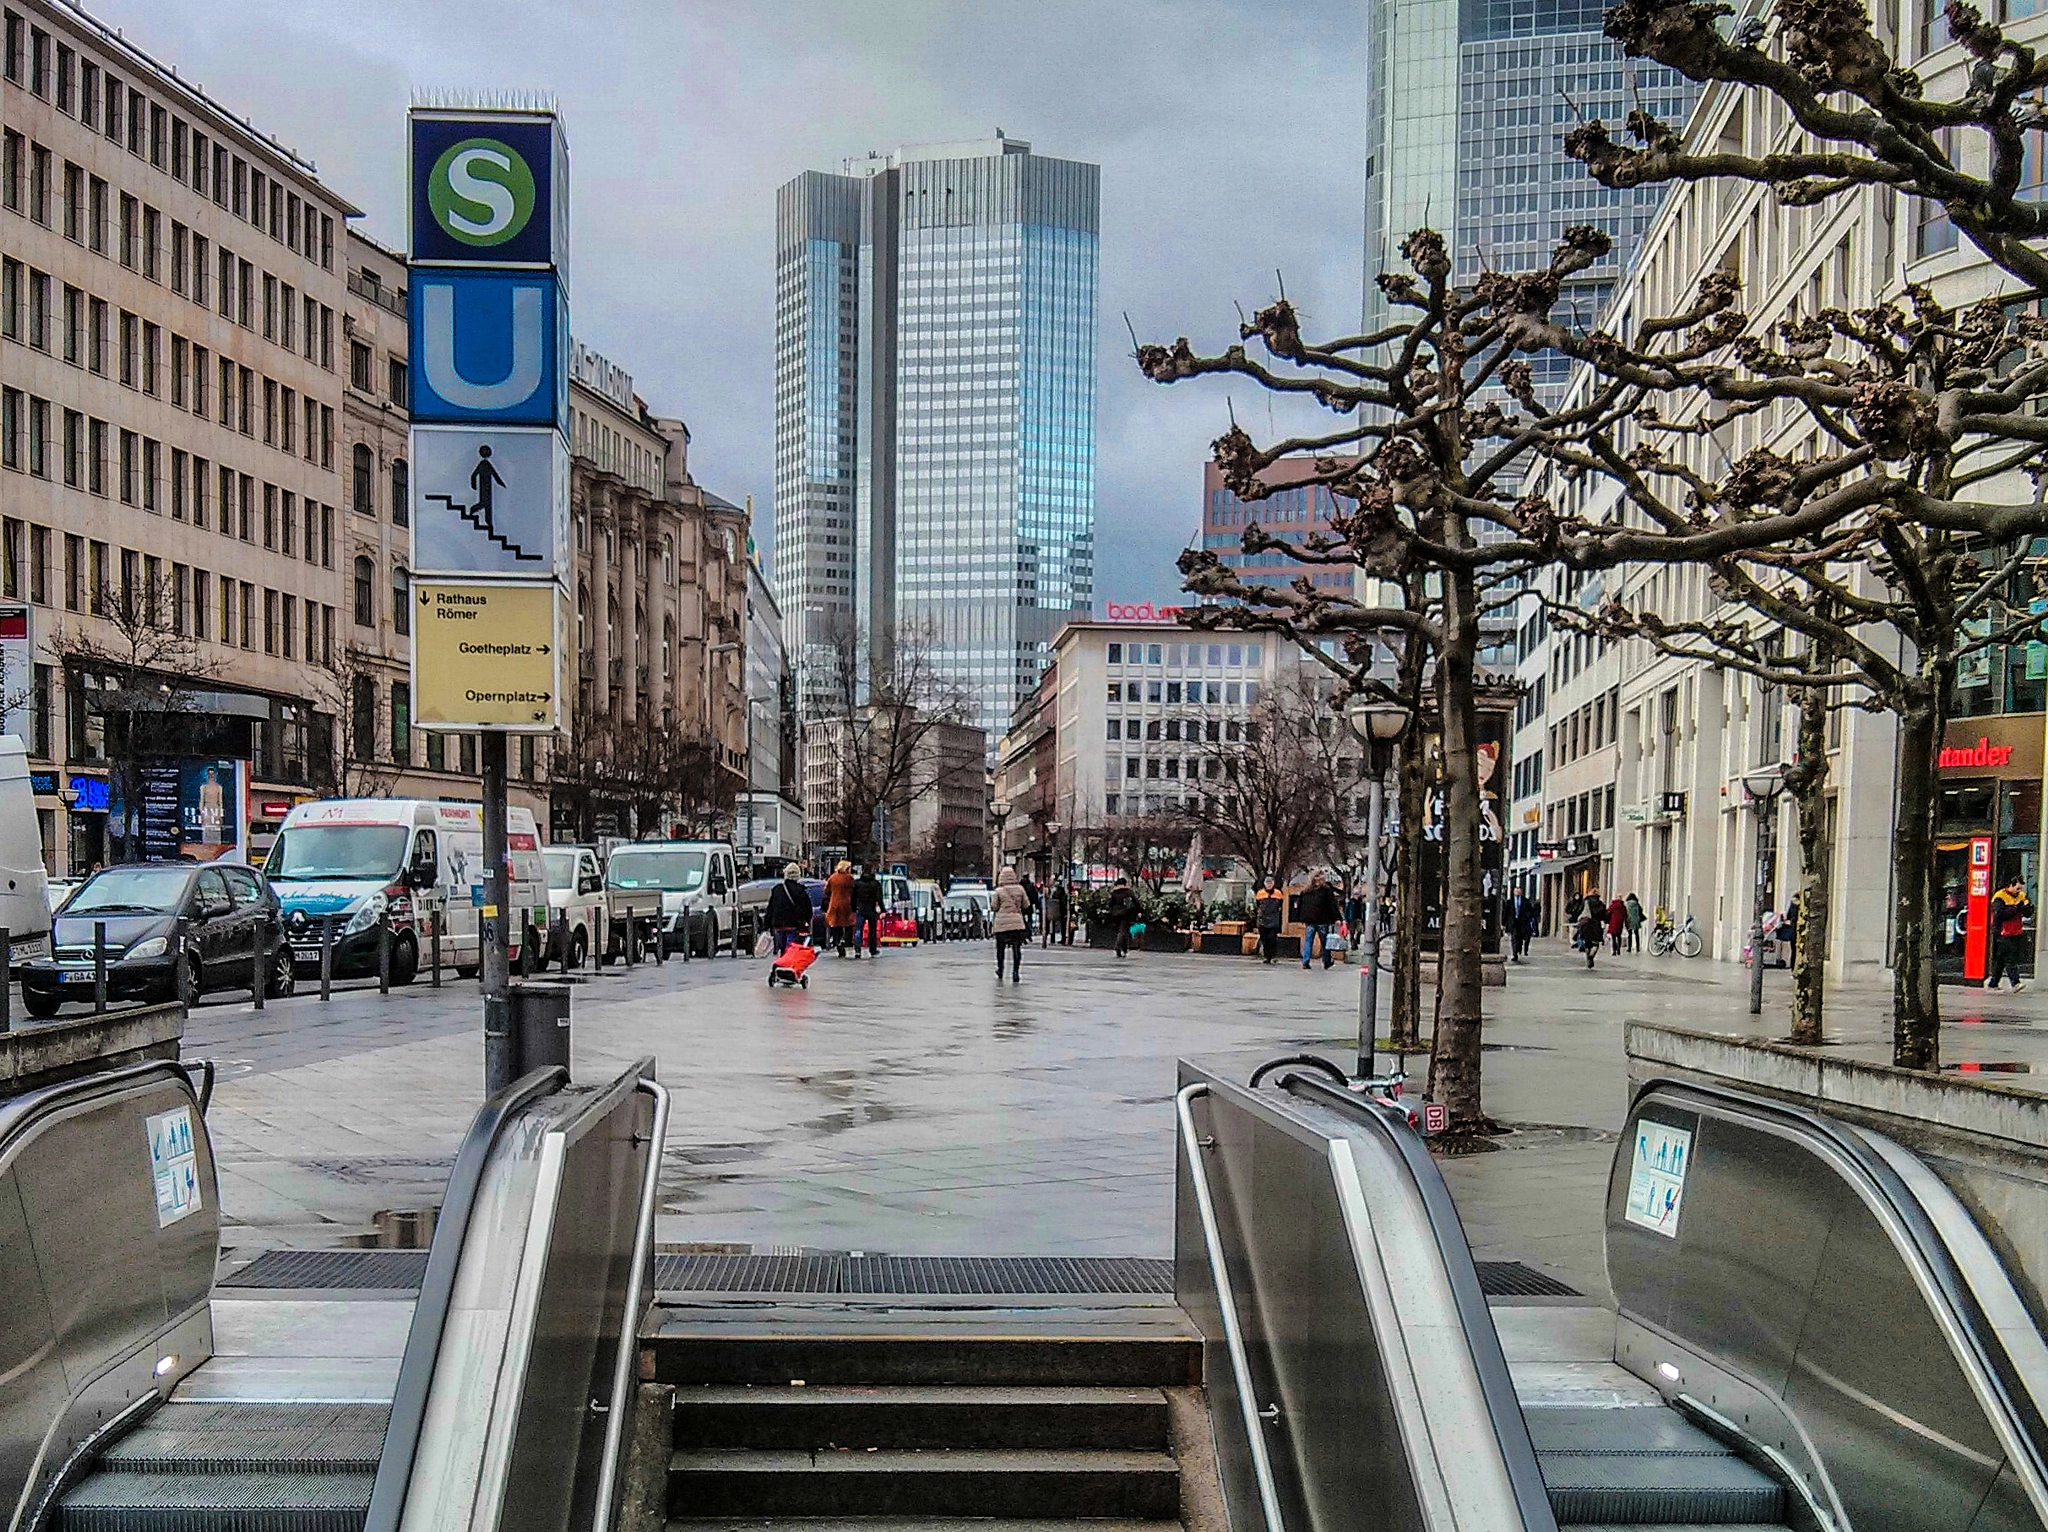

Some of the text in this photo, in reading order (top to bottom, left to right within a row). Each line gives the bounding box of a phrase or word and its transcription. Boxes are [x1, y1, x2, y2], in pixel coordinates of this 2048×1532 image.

[448, 149, 514, 235] S
[423, 284, 543, 410] U
[436, 593, 487, 605] Rathaus
[437, 608, 478, 619] Römer
[459, 642, 532, 657] Goetheplatz
[465, 689, 537, 704] Opernplatz
[1428, 1109, 1442, 1128] DB
